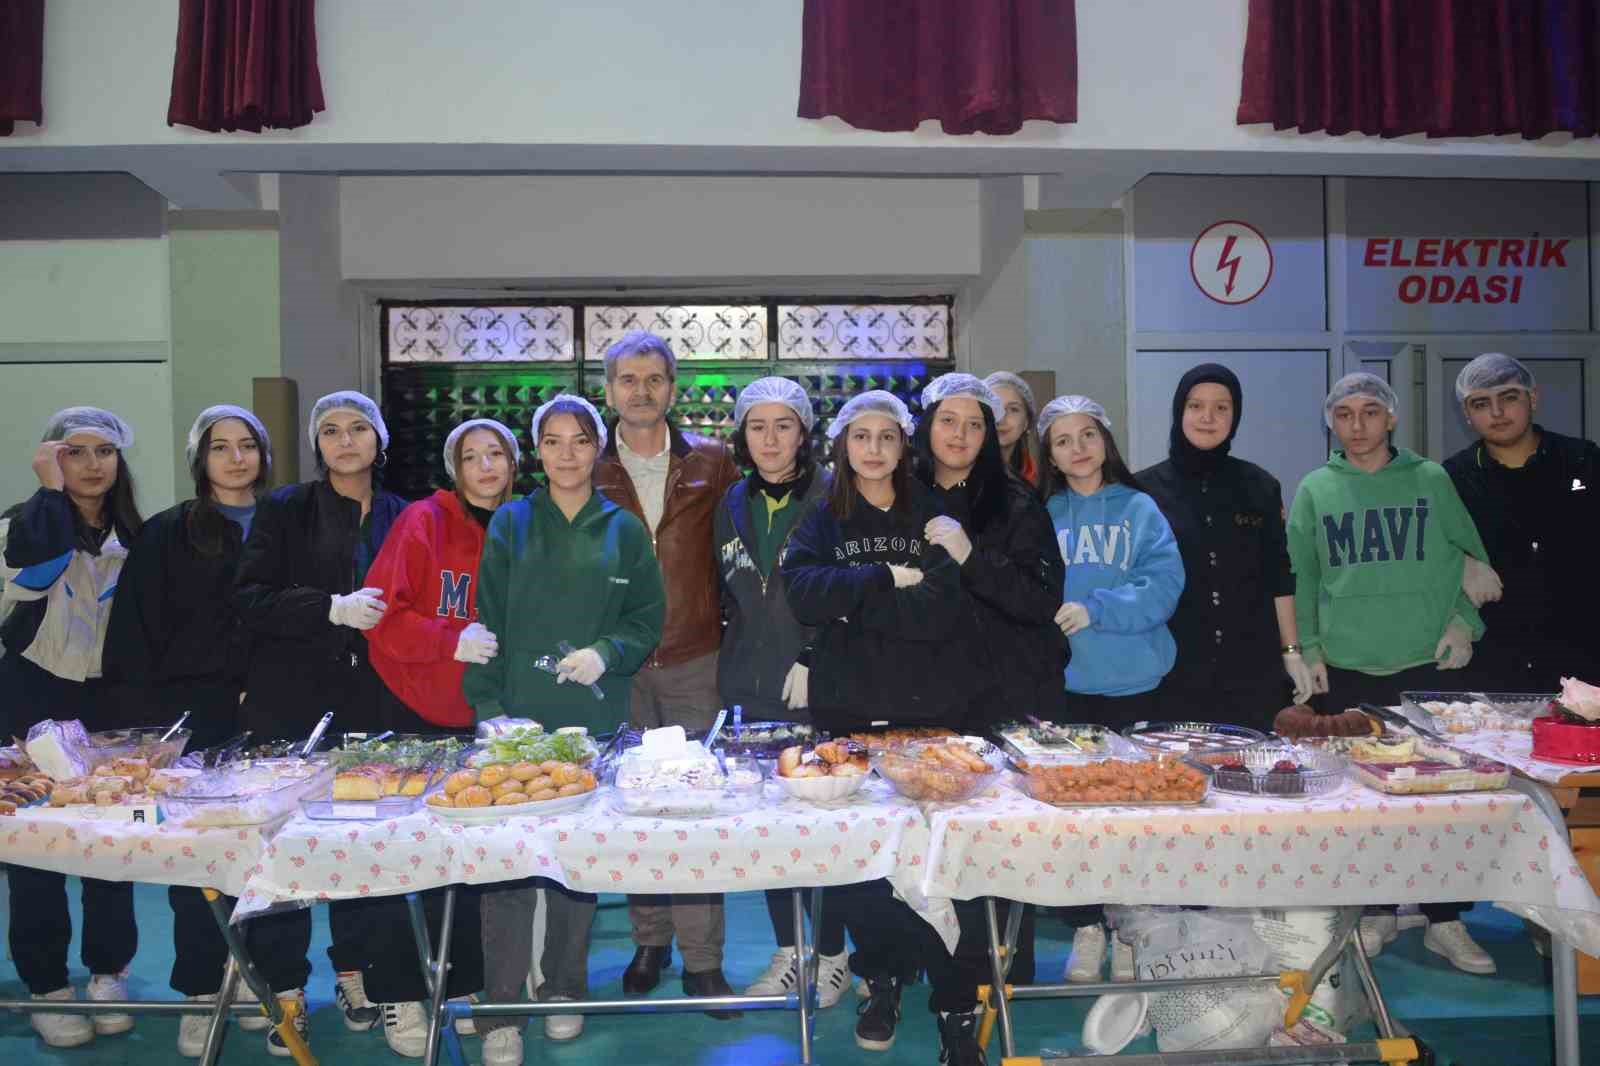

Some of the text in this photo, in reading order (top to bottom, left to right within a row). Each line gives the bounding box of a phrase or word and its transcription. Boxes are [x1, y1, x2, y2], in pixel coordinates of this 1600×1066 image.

[1363, 232, 1570, 267] ELEKTRİK
[1398, 275, 1523, 304] ODASI
[1321, 497, 1430, 568] MAVİ
[437, 569, 479, 620] M
